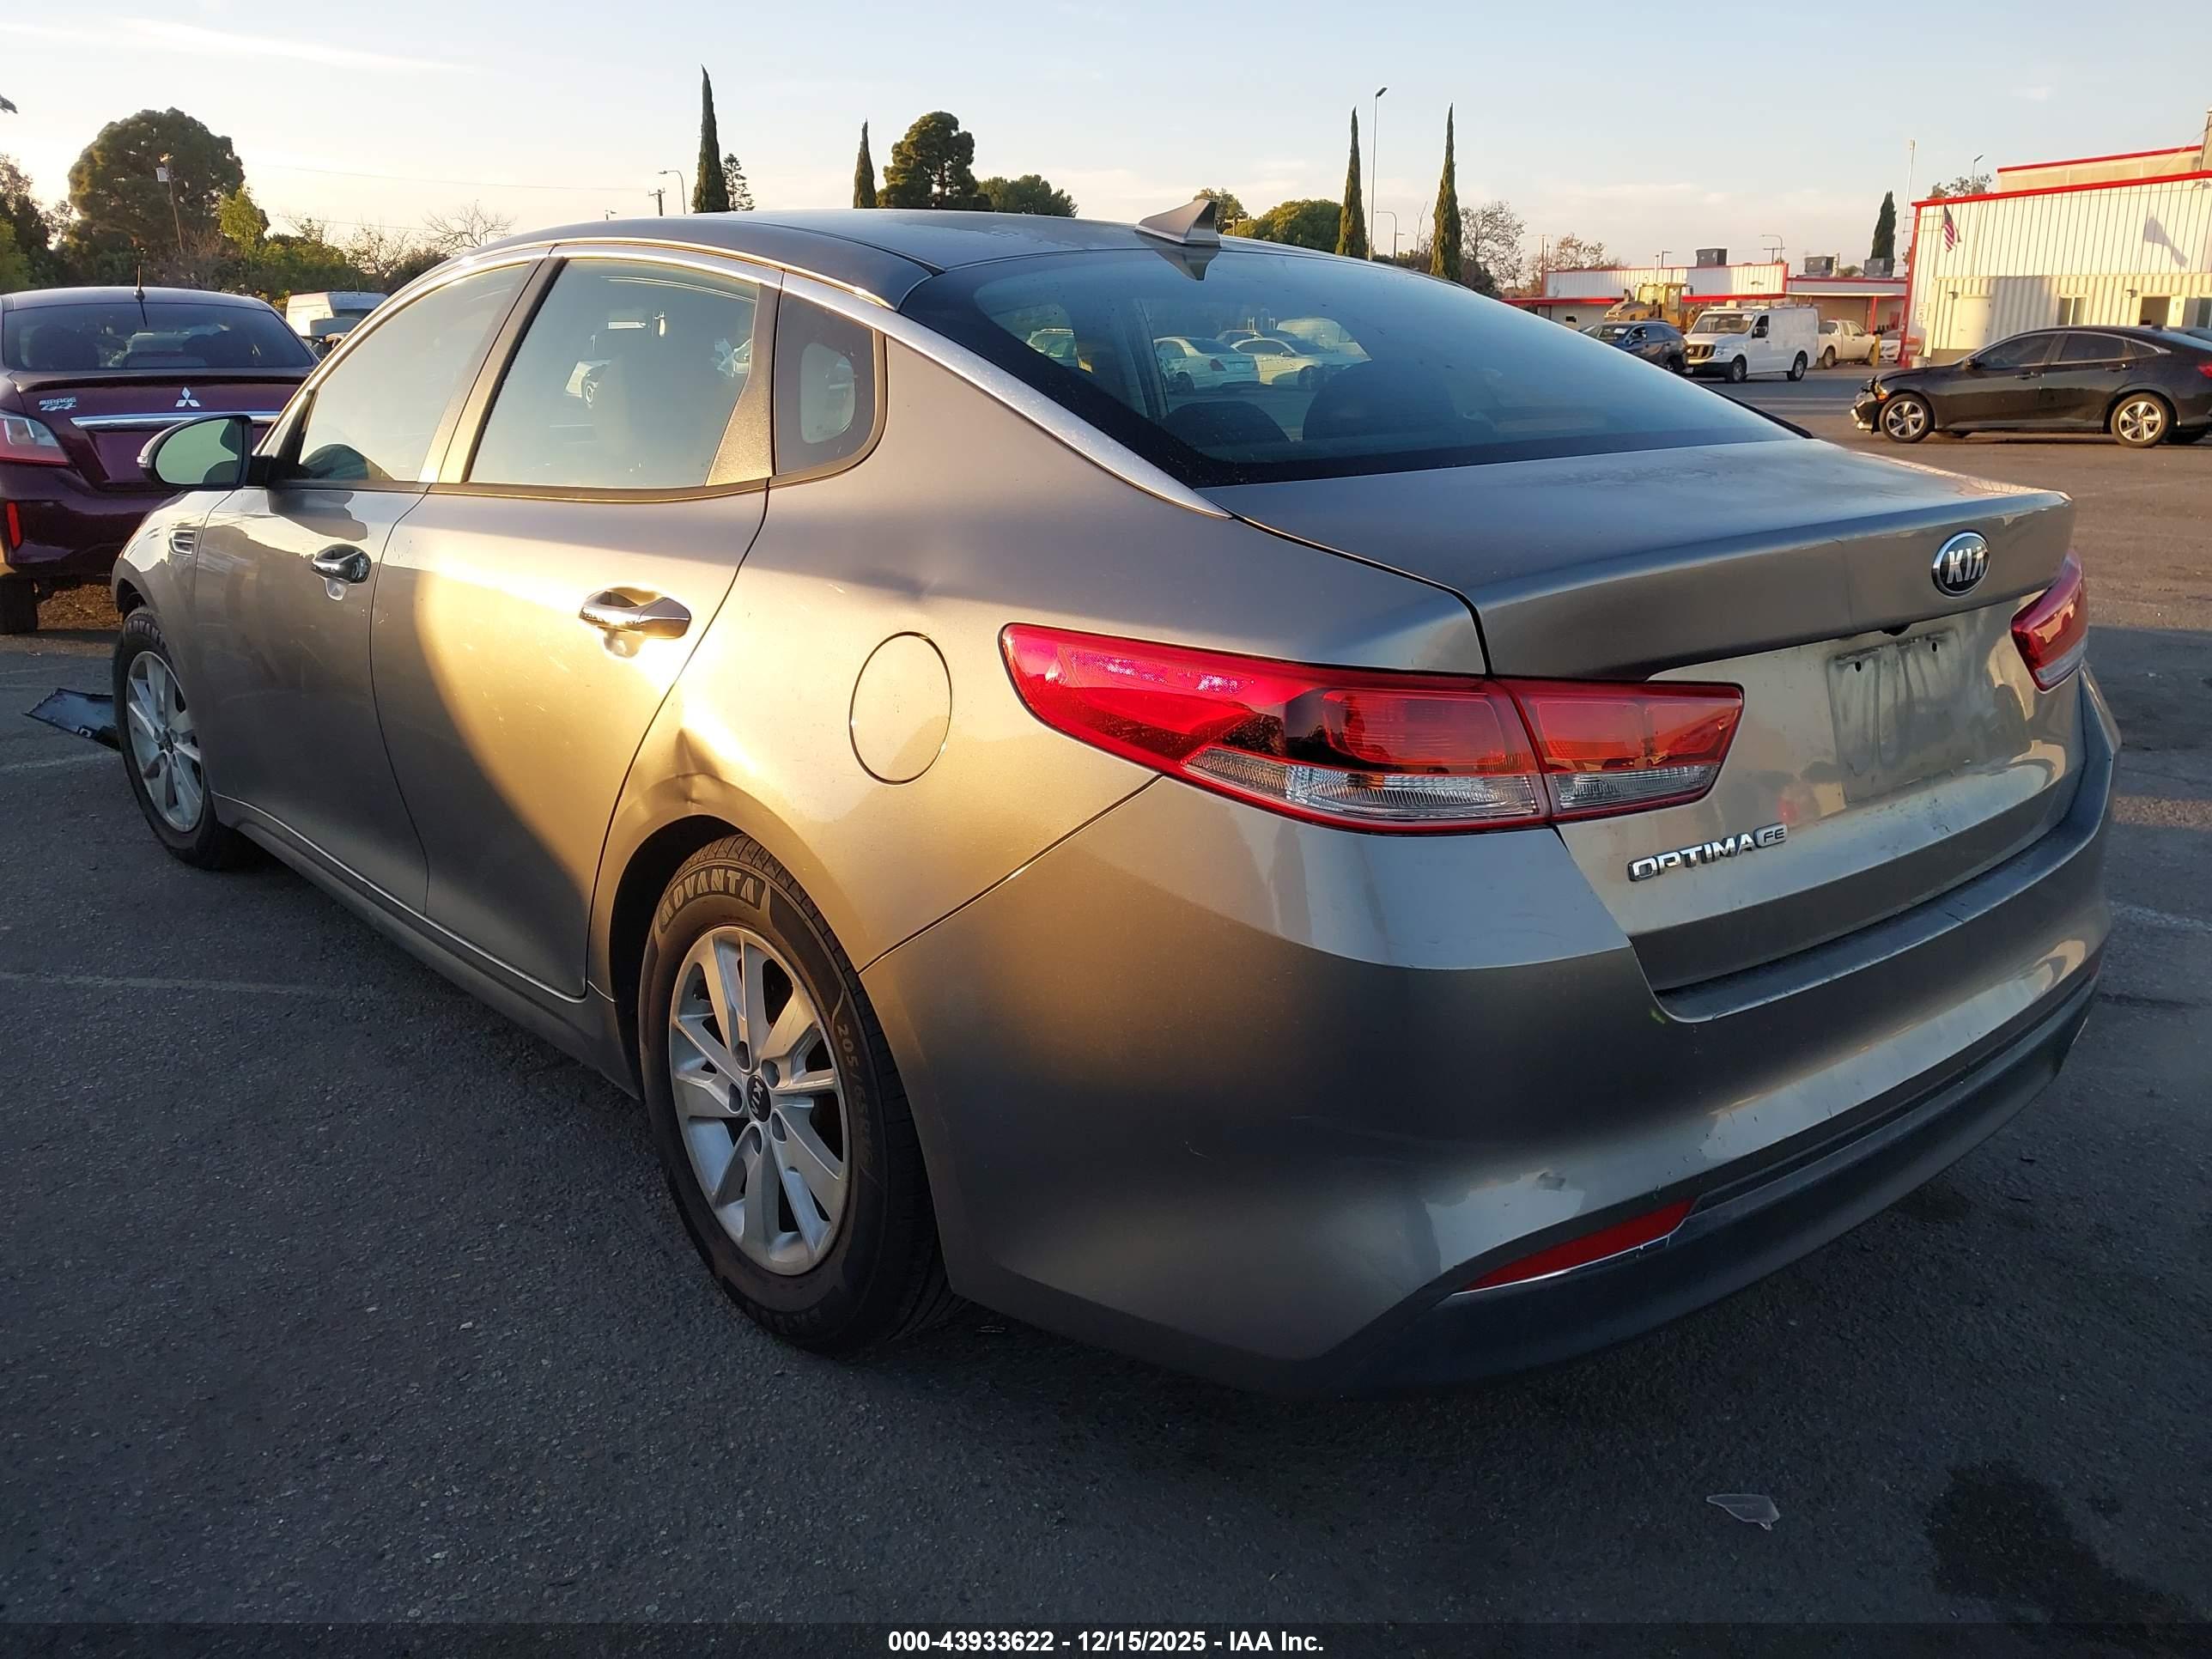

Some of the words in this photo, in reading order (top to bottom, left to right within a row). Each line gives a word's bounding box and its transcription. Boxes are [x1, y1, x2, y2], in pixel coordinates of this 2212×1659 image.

[1946, 545, 1987, 584] KIA
[1629, 832, 1756, 881] OPTIMA
[1763, 827, 1786, 843] FE
[659, 868, 759, 927] ADVANTA
[750, 1081, 764, 1115] KIA
